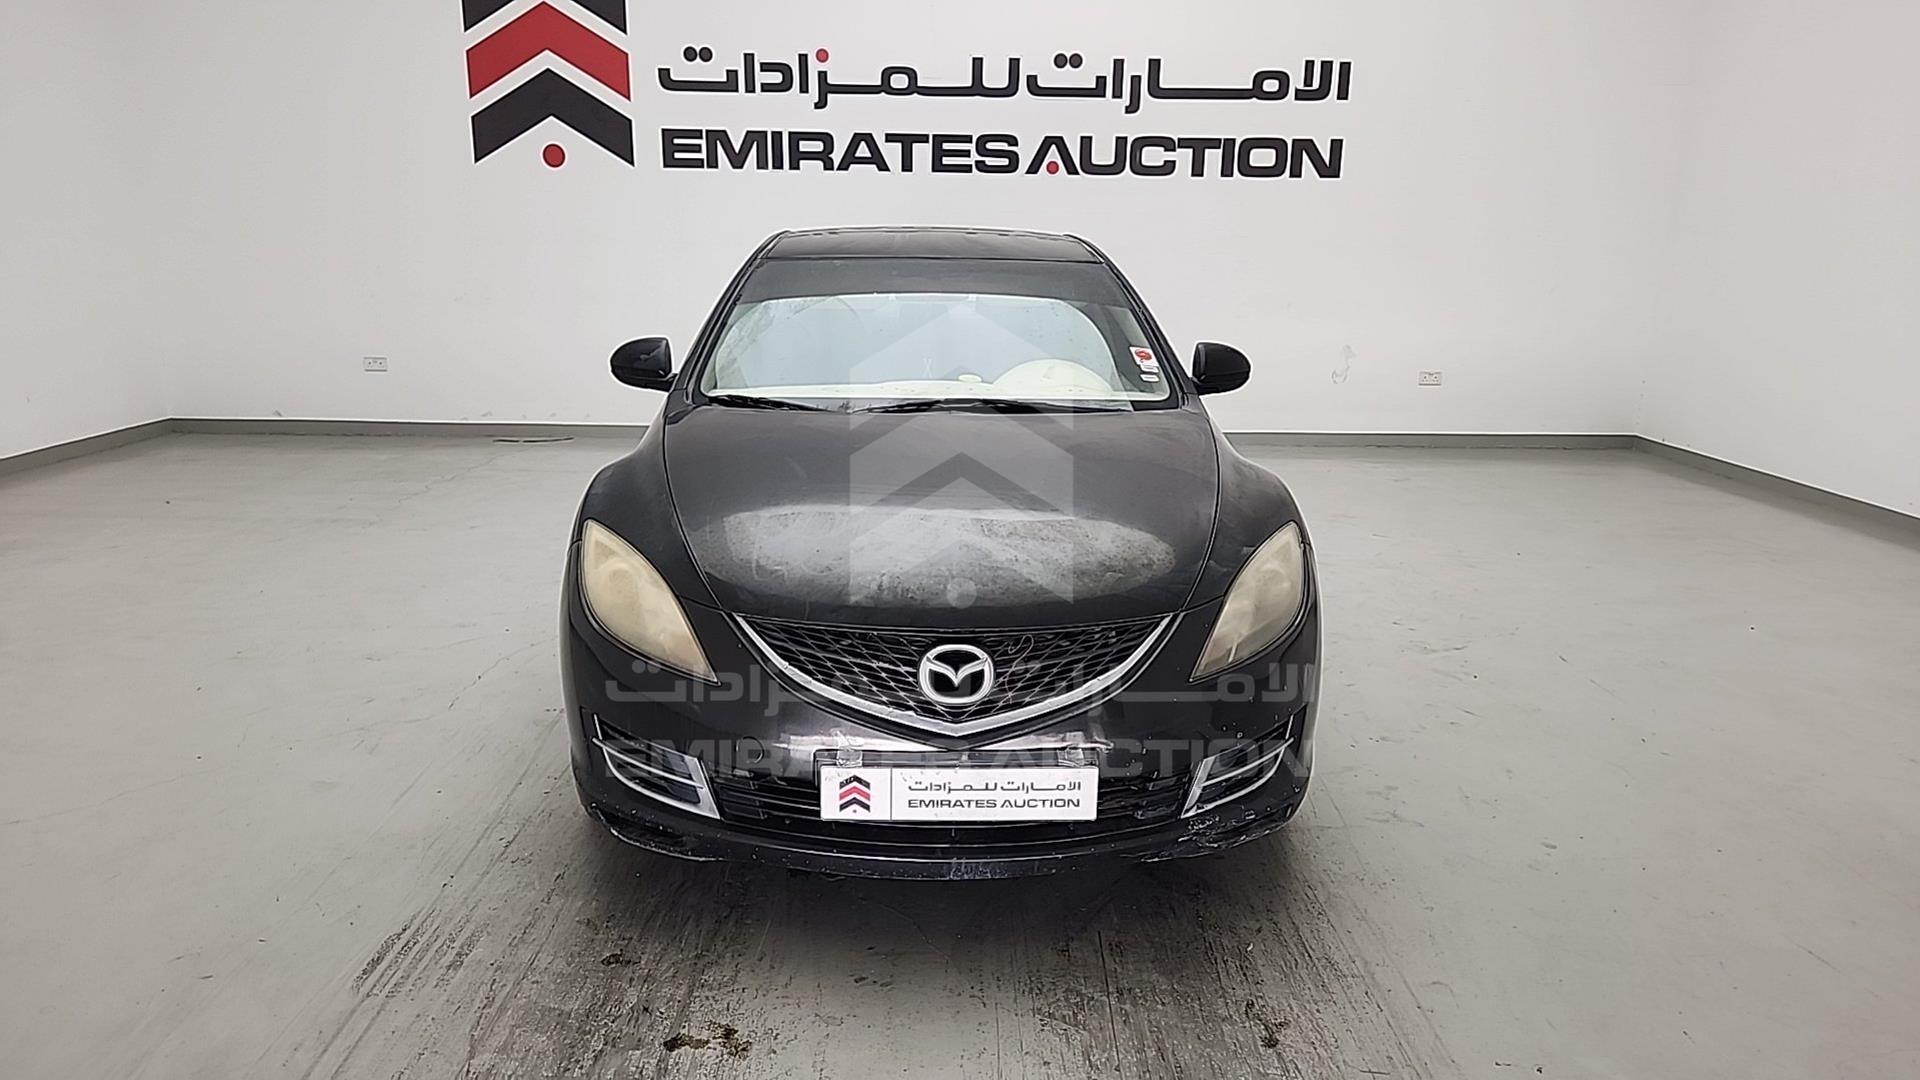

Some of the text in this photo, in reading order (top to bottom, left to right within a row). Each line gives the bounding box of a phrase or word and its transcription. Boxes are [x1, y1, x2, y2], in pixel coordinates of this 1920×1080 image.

[657, 46, 1351, 114] الامارات للمزادات
[661, 128, 1344, 179] EMIRATES AUCTION
[908, 781, 1081, 794] الامارات للمزادات
[908, 798, 1081, 809] EMIRATES AUCTION
